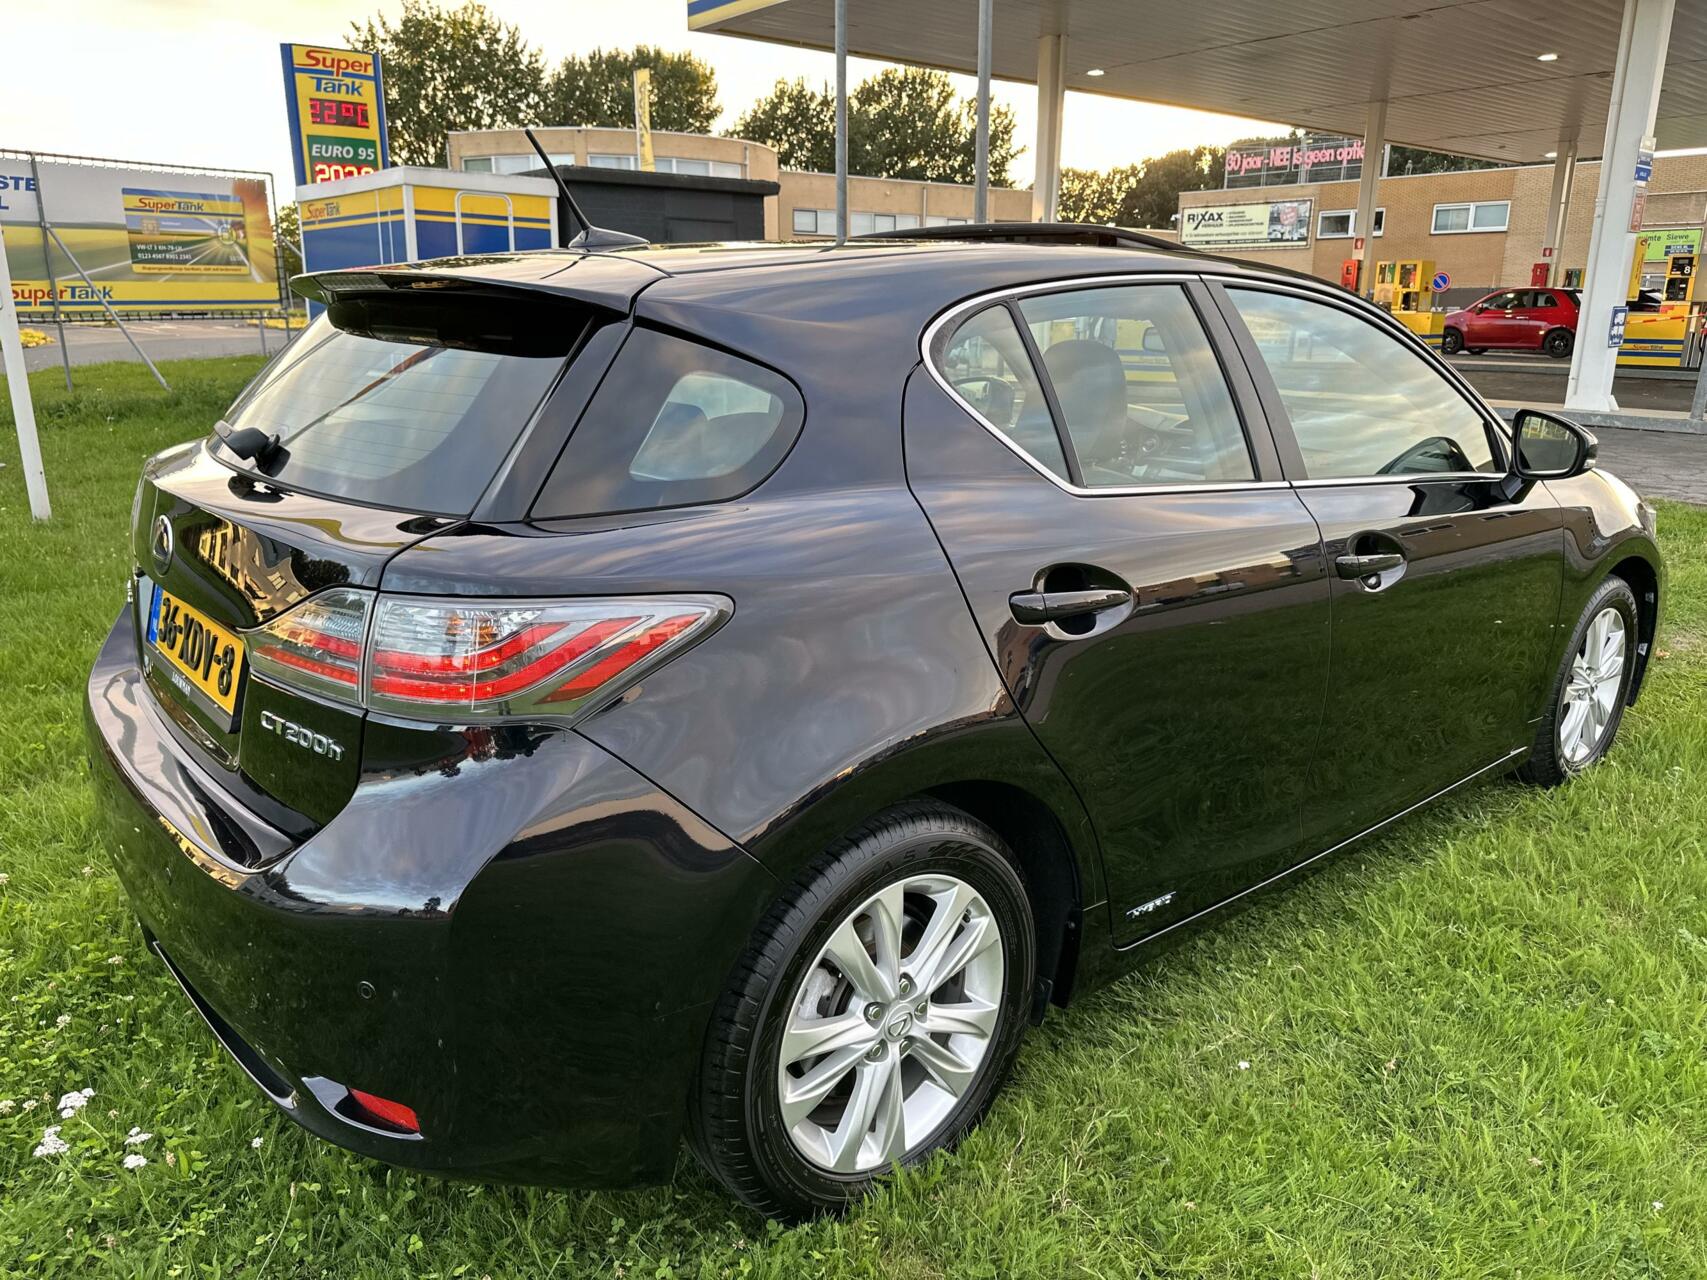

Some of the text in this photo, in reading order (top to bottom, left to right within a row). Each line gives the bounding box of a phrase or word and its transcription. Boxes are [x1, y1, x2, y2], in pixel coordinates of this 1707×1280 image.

[294, 49, 372, 77] Super
[308, 76, 364, 97] Tank
[311, 144, 375, 161] EURO 95
[1304, 149, 1335, 169] geen
[134, 197, 204, 216] SuperTank
[1684, 266, 1691, 274] 8
[158, 597, 235, 697] 36-XDV-8
[260, 710, 345, 761] CT200h
